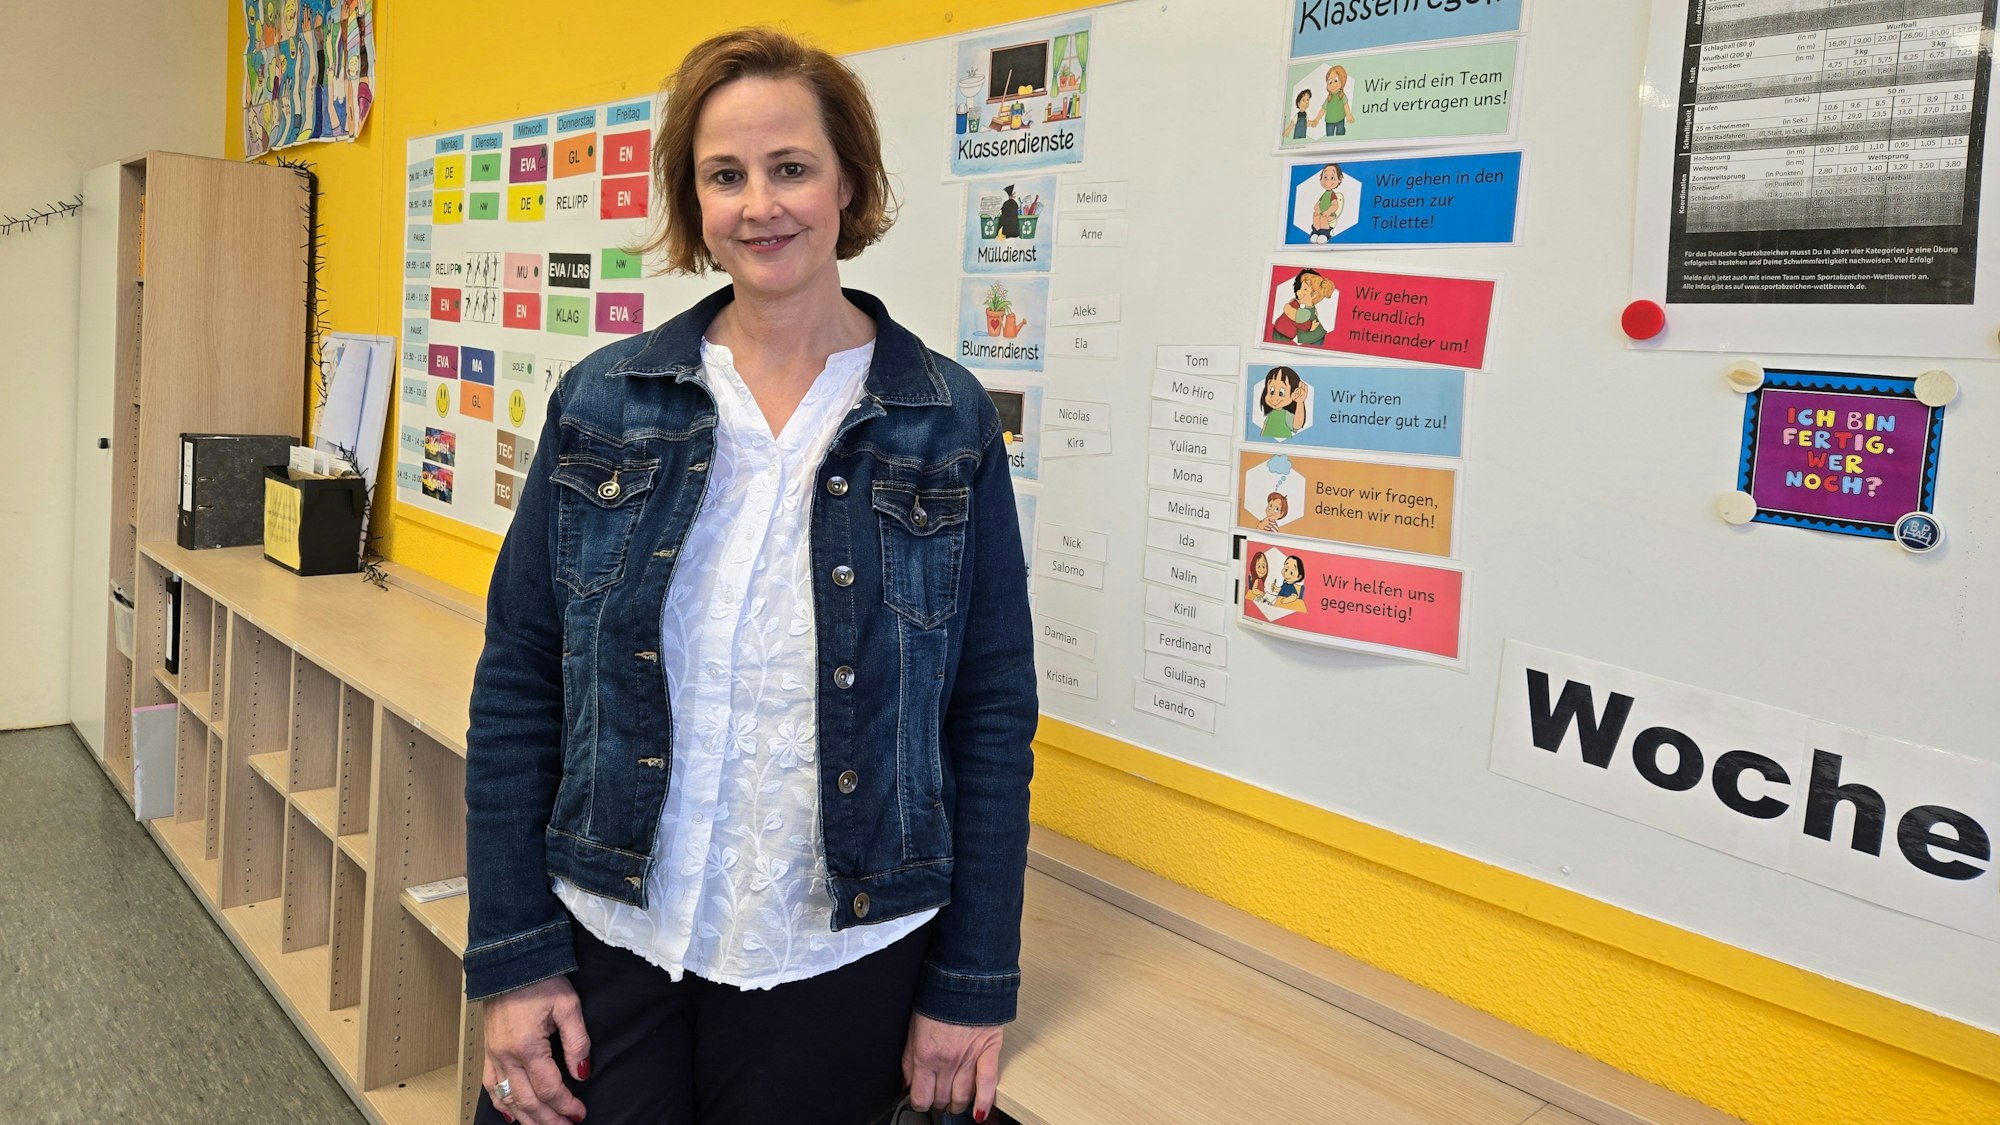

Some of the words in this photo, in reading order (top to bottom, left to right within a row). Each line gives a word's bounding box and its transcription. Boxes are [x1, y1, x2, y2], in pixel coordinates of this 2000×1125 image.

[1887, 21, 1917, 31] Wurfball
[1704, 42, 1735, 52] Schlagball
[1689, 66, 1697, 84] Kraft
[1702, 62, 1741, 72] Kugelstoßen
[1364, 77, 1390, 93] Wir
[1395, 74, 1427, 91] sind
[1431, 73, 1454, 87] ein
[1460, 70, 1502, 85] Team
[1362, 98, 1389, 114] und
[1393, 95, 1469, 114] vertragen
[1474, 90, 1508, 107] uns!
[1697, 105, 1719, 113] Laufen
[616, 106, 641, 121] Freitag
[518, 123, 543, 137] Mittwoch
[558, 114, 594, 131] Donnerstag
[1683, 109, 1692, 150] Schnelligkeit
[440, 140, 458, 152] Montag
[475, 135, 498, 149] Dienstag
[957, 129, 1075, 161] Klassendienste
[568, 151, 580, 164] GL
[619, 146, 633, 162] EN
[1868, 152, 1909, 162] Weitsprung
[445, 166, 454, 179] DE
[481, 163, 491, 173] NW
[520, 158, 537, 172] EVA
[1692, 164, 1728, 173] Weitsprung
[1375, 173, 1402, 188] Wir
[1406, 172, 1451, 190] gehen
[1455, 170, 1470, 185] in
[1474, 168, 1504, 184] den
[617, 191, 632, 206] EN
[1076, 191, 1108, 204] Melina
[1373, 194, 1425, 209] Pausen
[1429, 194, 1455, 208] zur
[1679, 173, 1687, 214] Koordination
[443, 202, 452, 214] DE
[479, 202, 489, 211] NW
[521, 197, 531, 210] DE
[556, 194, 589, 210] RELI/PP
[1371, 215, 1434, 230] Toilette!
[1080, 228, 1102, 240] Arne
[977, 246, 1037, 264] Mülldienst
[1708, 250, 1738, 258] Deutsche
[1738, 249, 1789, 259] Sportabzeichen
[1865, 247, 1905, 256] Kategorien
[1906, 247, 1914, 255] je
[1933, 245, 1958, 254] Übung
[616, 259, 627, 269] NW
[1684, 259, 1717, 267] erfolgreich
[1783, 257, 1847, 266] Schwimmfertigkeit
[1910, 256, 1934, 265] Erfolg!
[517, 266, 528, 279] MU
[549, 262, 566, 278] EVA
[573, 263, 590, 279] LRS
[1817, 273, 1916, 282] Sportabzeichen-Wettbewerb
[1355, 286, 1381, 300] Wir
[1384, 288, 1429, 306] gehen
[440, 299, 449, 312] EN
[516, 304, 527, 318] EN
[1072, 305, 1097, 317] Aleks
[556, 308, 580, 324] KLAG
[609, 306, 629, 322] EVA
[1352, 306, 1426, 327] freundlich
[1075, 338, 1088, 349] Ela
[1349, 329, 1437, 350] miteinander
[1440, 338, 1469, 353] um!
[962, 341, 1040, 361] Blumendienst
[436, 355, 449, 369] EVA
[472, 360, 483, 374] MA
[511, 362, 525, 373] SOLE
[1185, 354, 1209, 367] Tom
[1172, 381, 1189, 395] Mo
[1192, 385, 1215, 401] Hiro
[1330, 389, 1356, 403] Wir
[1360, 390, 1402, 406] hören
[471, 394, 481, 408] GL
[1058, 408, 1090, 423] Nicolas
[1174, 411, 1209, 426] Leonie
[1330, 411, 1392, 427] einander
[1396, 413, 1420, 431] gut
[1424, 415, 1447, 430] zu!
[1787, 406, 1836, 429] ICH
[1846, 411, 1897, 433] BIN
[1067, 437, 1085, 449] Kira
[1169, 440, 1207, 456] Yuliana
[1782, 428, 1895, 456] FERTIG.
[498, 443, 512, 460] TEC
[1806, 450, 1865, 475] WER
[1173, 468, 1204, 484] Mona
[496, 483, 511, 500] TEC
[1785, 471, 1883, 498] NOCH?
[1316, 481, 1355, 498] Bevor
[1358, 487, 1381, 500] wir
[1385, 488, 1438, 511] fragen,
[1168, 501, 1210, 520] Melinda
[1315, 501, 1363, 519] denken
[1367, 509, 1391, 522] wir
[1394, 513, 1435, 529] nach!
[1062, 534, 1082, 550] Nick
[1179, 534, 1196, 549] Ida
[1052, 560, 1085, 577] Salomo
[1170, 565, 1198, 584] Nalin
[1322, 572, 1349, 588] Wir
[1353, 576, 1403, 598] helfen
[1407, 588, 1436, 603] uns
[1173, 601, 1197, 619] Kirill
[1320, 597, 1412, 623] gegenseitig!
[1044, 625, 1078, 646] Damian
[1159, 633, 1212, 655] Ferdinand
[1046, 668, 1080, 688] Kristian
[1164, 666, 1206, 688] Giuliana
[1153, 694, 1195, 718] Leandro
[1526, 667, 1991, 882] Woche
